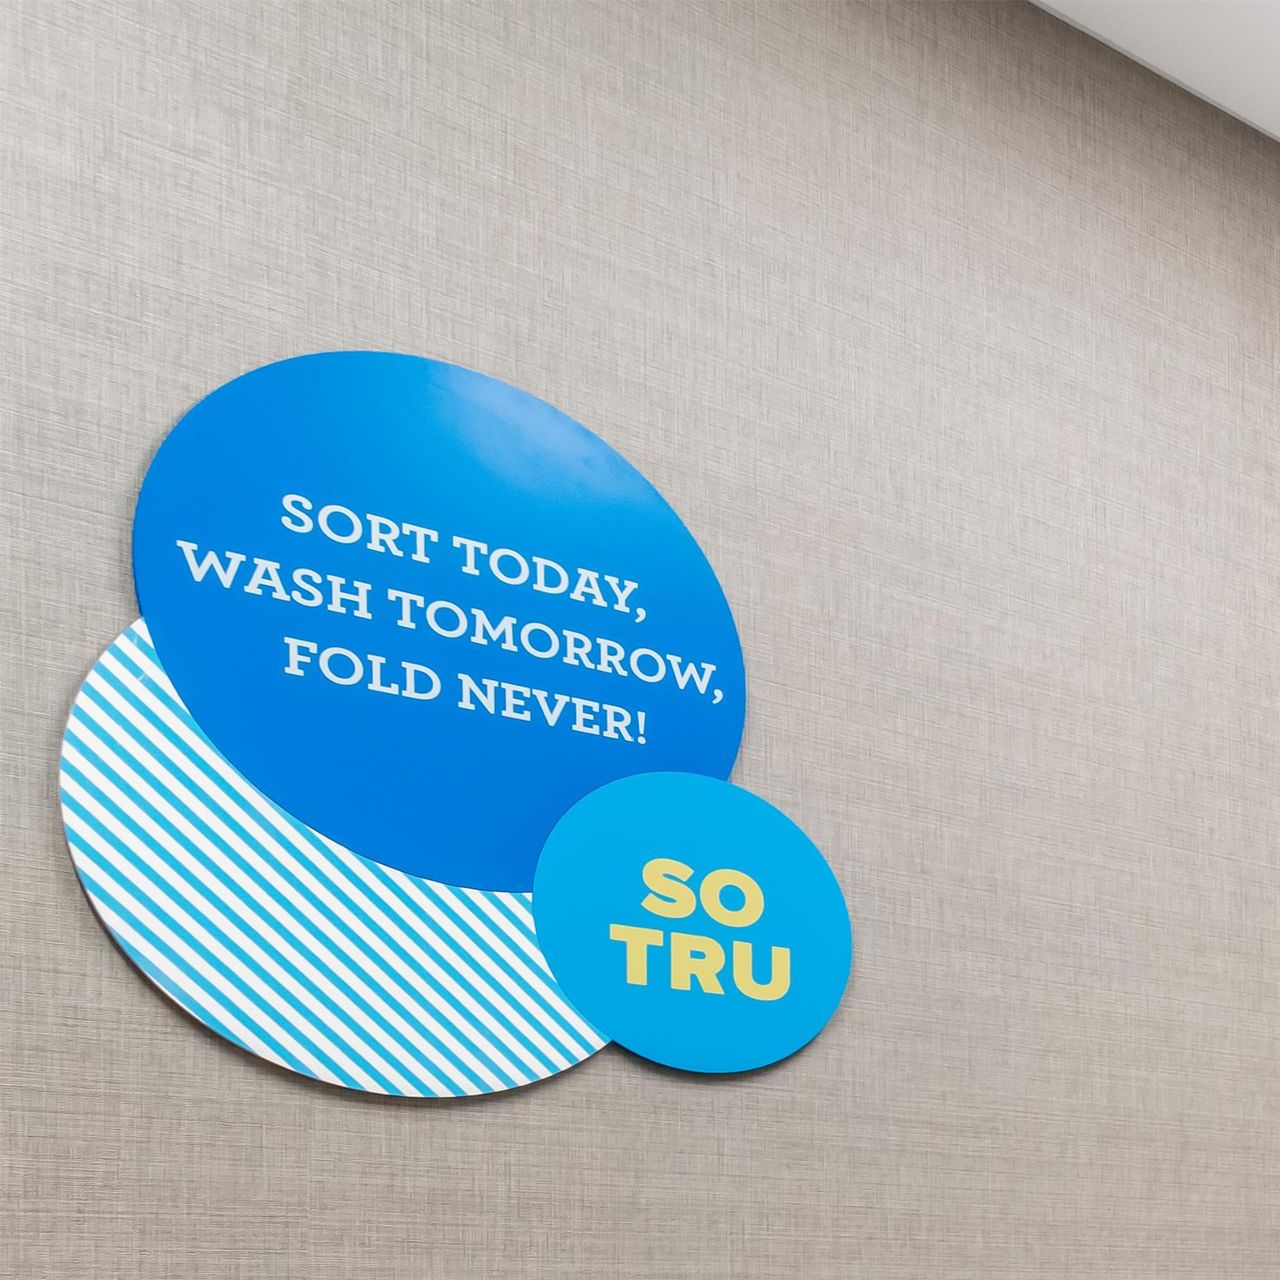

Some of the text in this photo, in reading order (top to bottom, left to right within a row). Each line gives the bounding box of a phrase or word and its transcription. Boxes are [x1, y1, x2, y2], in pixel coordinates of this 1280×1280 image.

[281, 494, 647, 623] SORT TODAY,
[176, 540, 725, 704] WASH TOMORROW,
[284, 637, 647, 746] FOLD NEVER!
[642, 858, 764, 926] SO
[609, 922, 790, 1002] TRU
